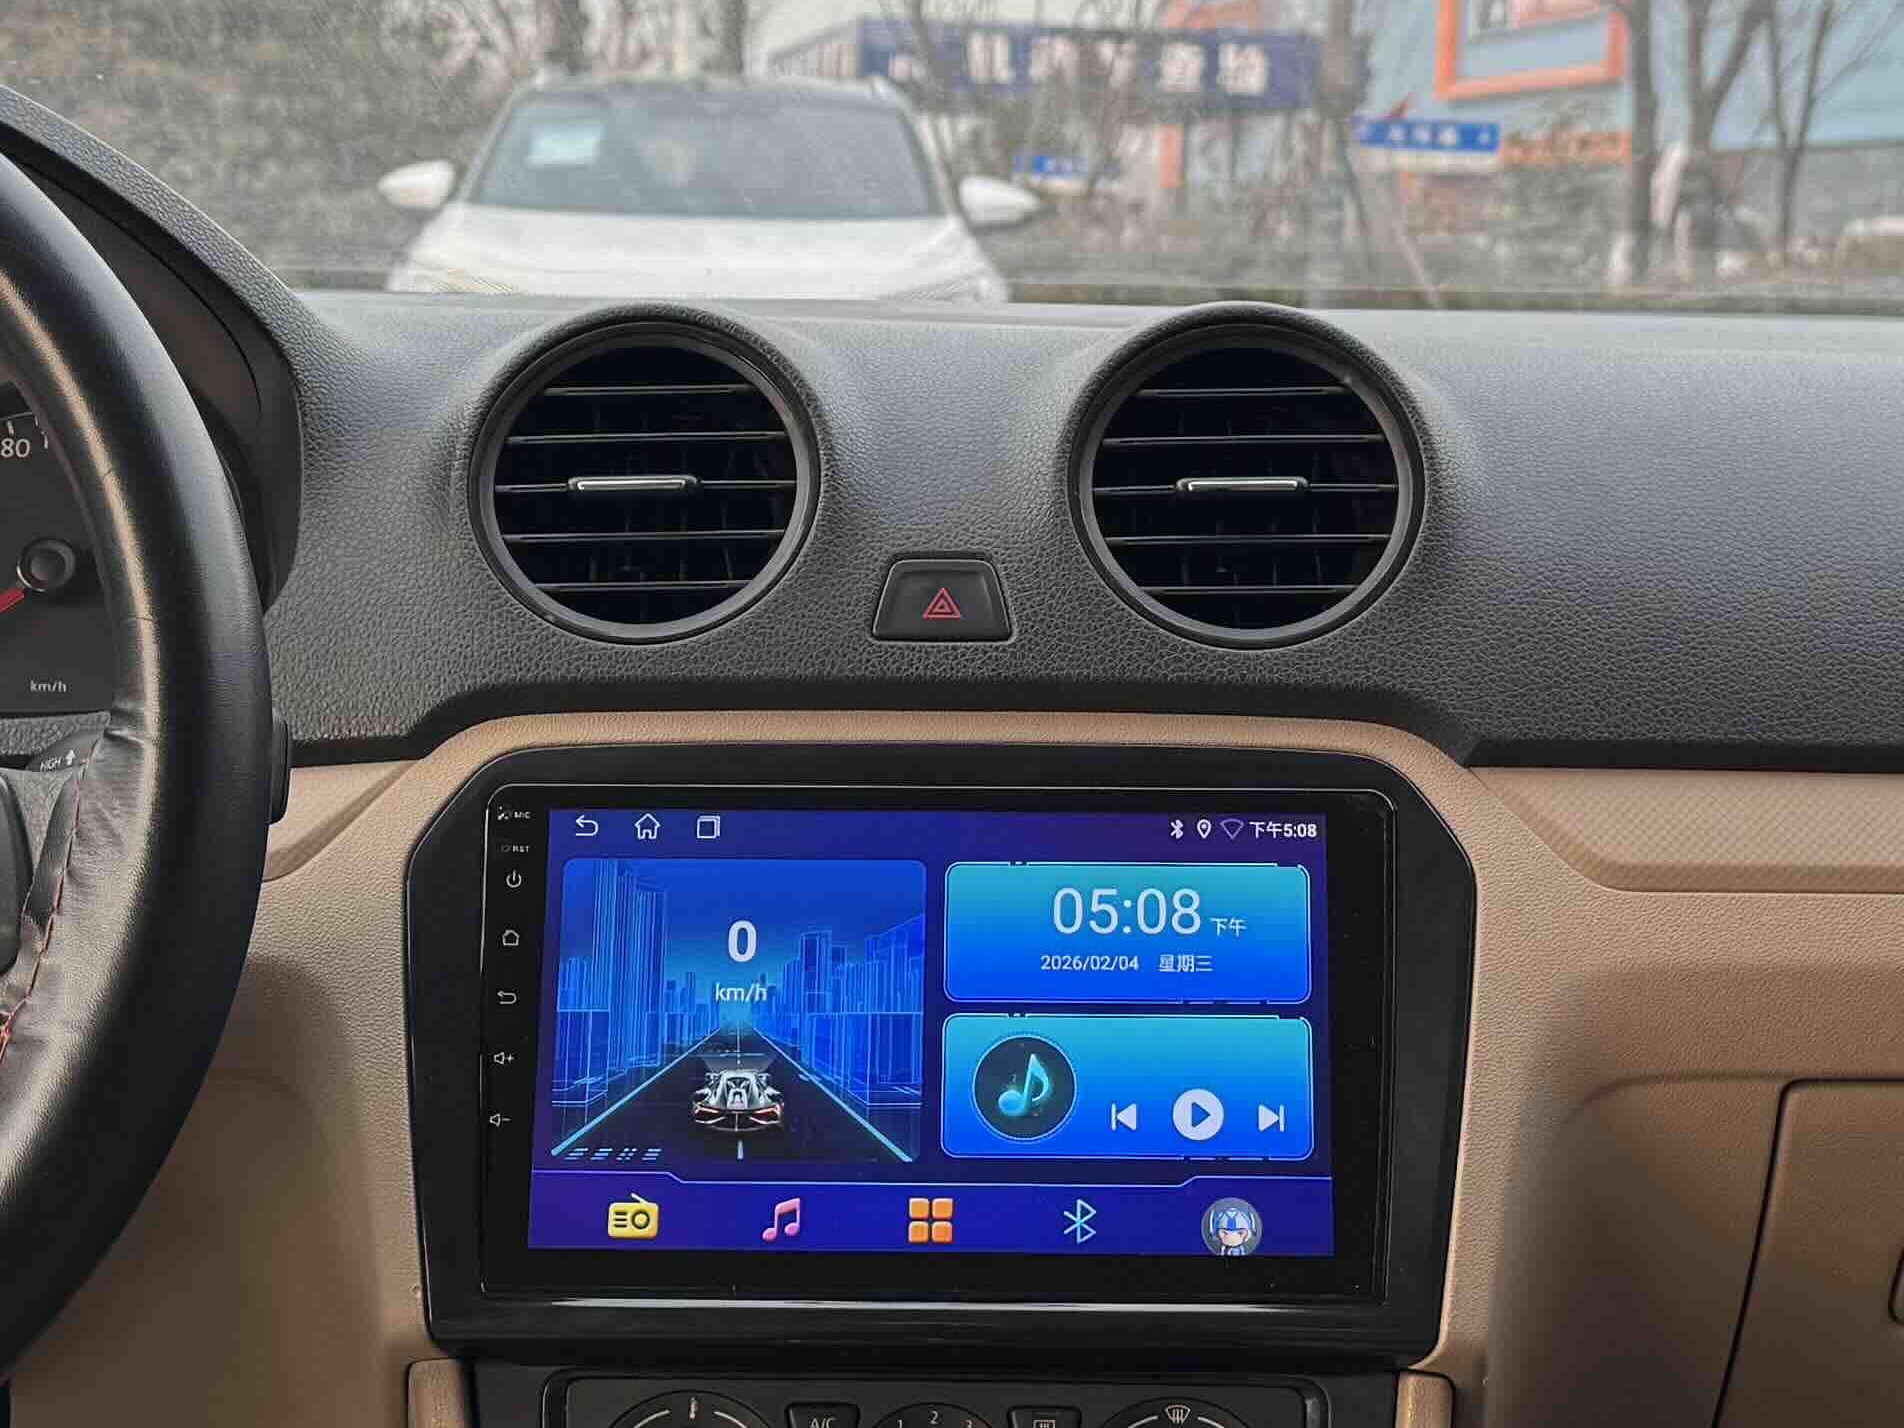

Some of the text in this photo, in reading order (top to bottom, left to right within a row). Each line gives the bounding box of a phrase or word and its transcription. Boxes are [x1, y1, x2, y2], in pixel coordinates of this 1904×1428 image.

[0, 438, 31, 458] 80
[29, 680, 68, 693] km/h
[1248, 821, 1317, 839] 下午5:08
[1053, 887, 1247, 937] 05:08 下午
[728, 920, 757, 962] 0
[1040, 954, 1214, 972] 2026/02/04 星期三
[715, 981, 768, 1003] km/h
[930, 1410, 939, 1425] 2
